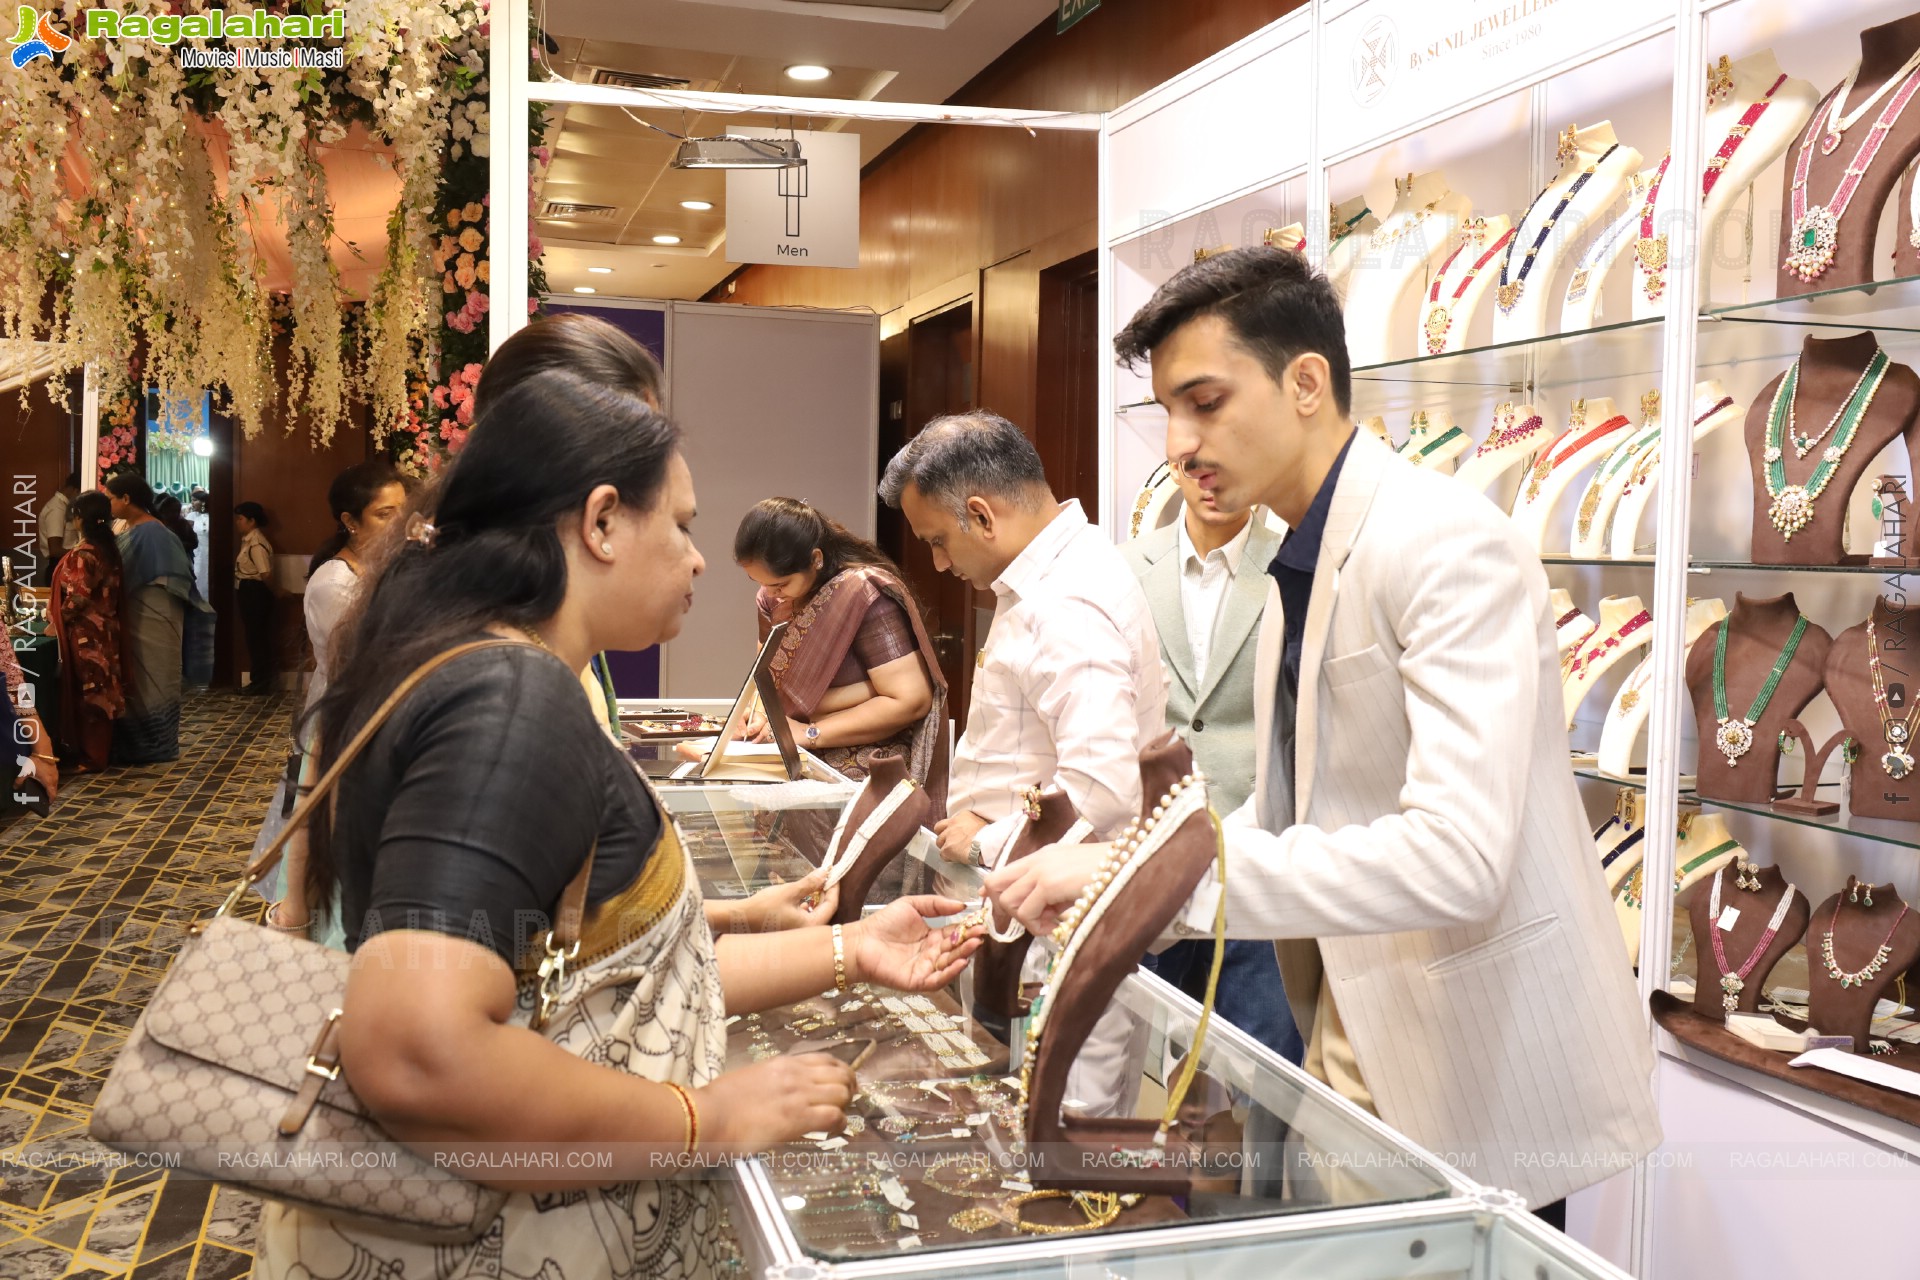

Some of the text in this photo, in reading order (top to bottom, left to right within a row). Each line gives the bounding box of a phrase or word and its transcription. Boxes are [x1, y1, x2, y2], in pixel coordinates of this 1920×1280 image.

[1410, 0, 1559, 71] By SUNIL JEWELLE
[1481, 23, 1542, 60] Since 1980
[777, 244, 808, 257] Men
